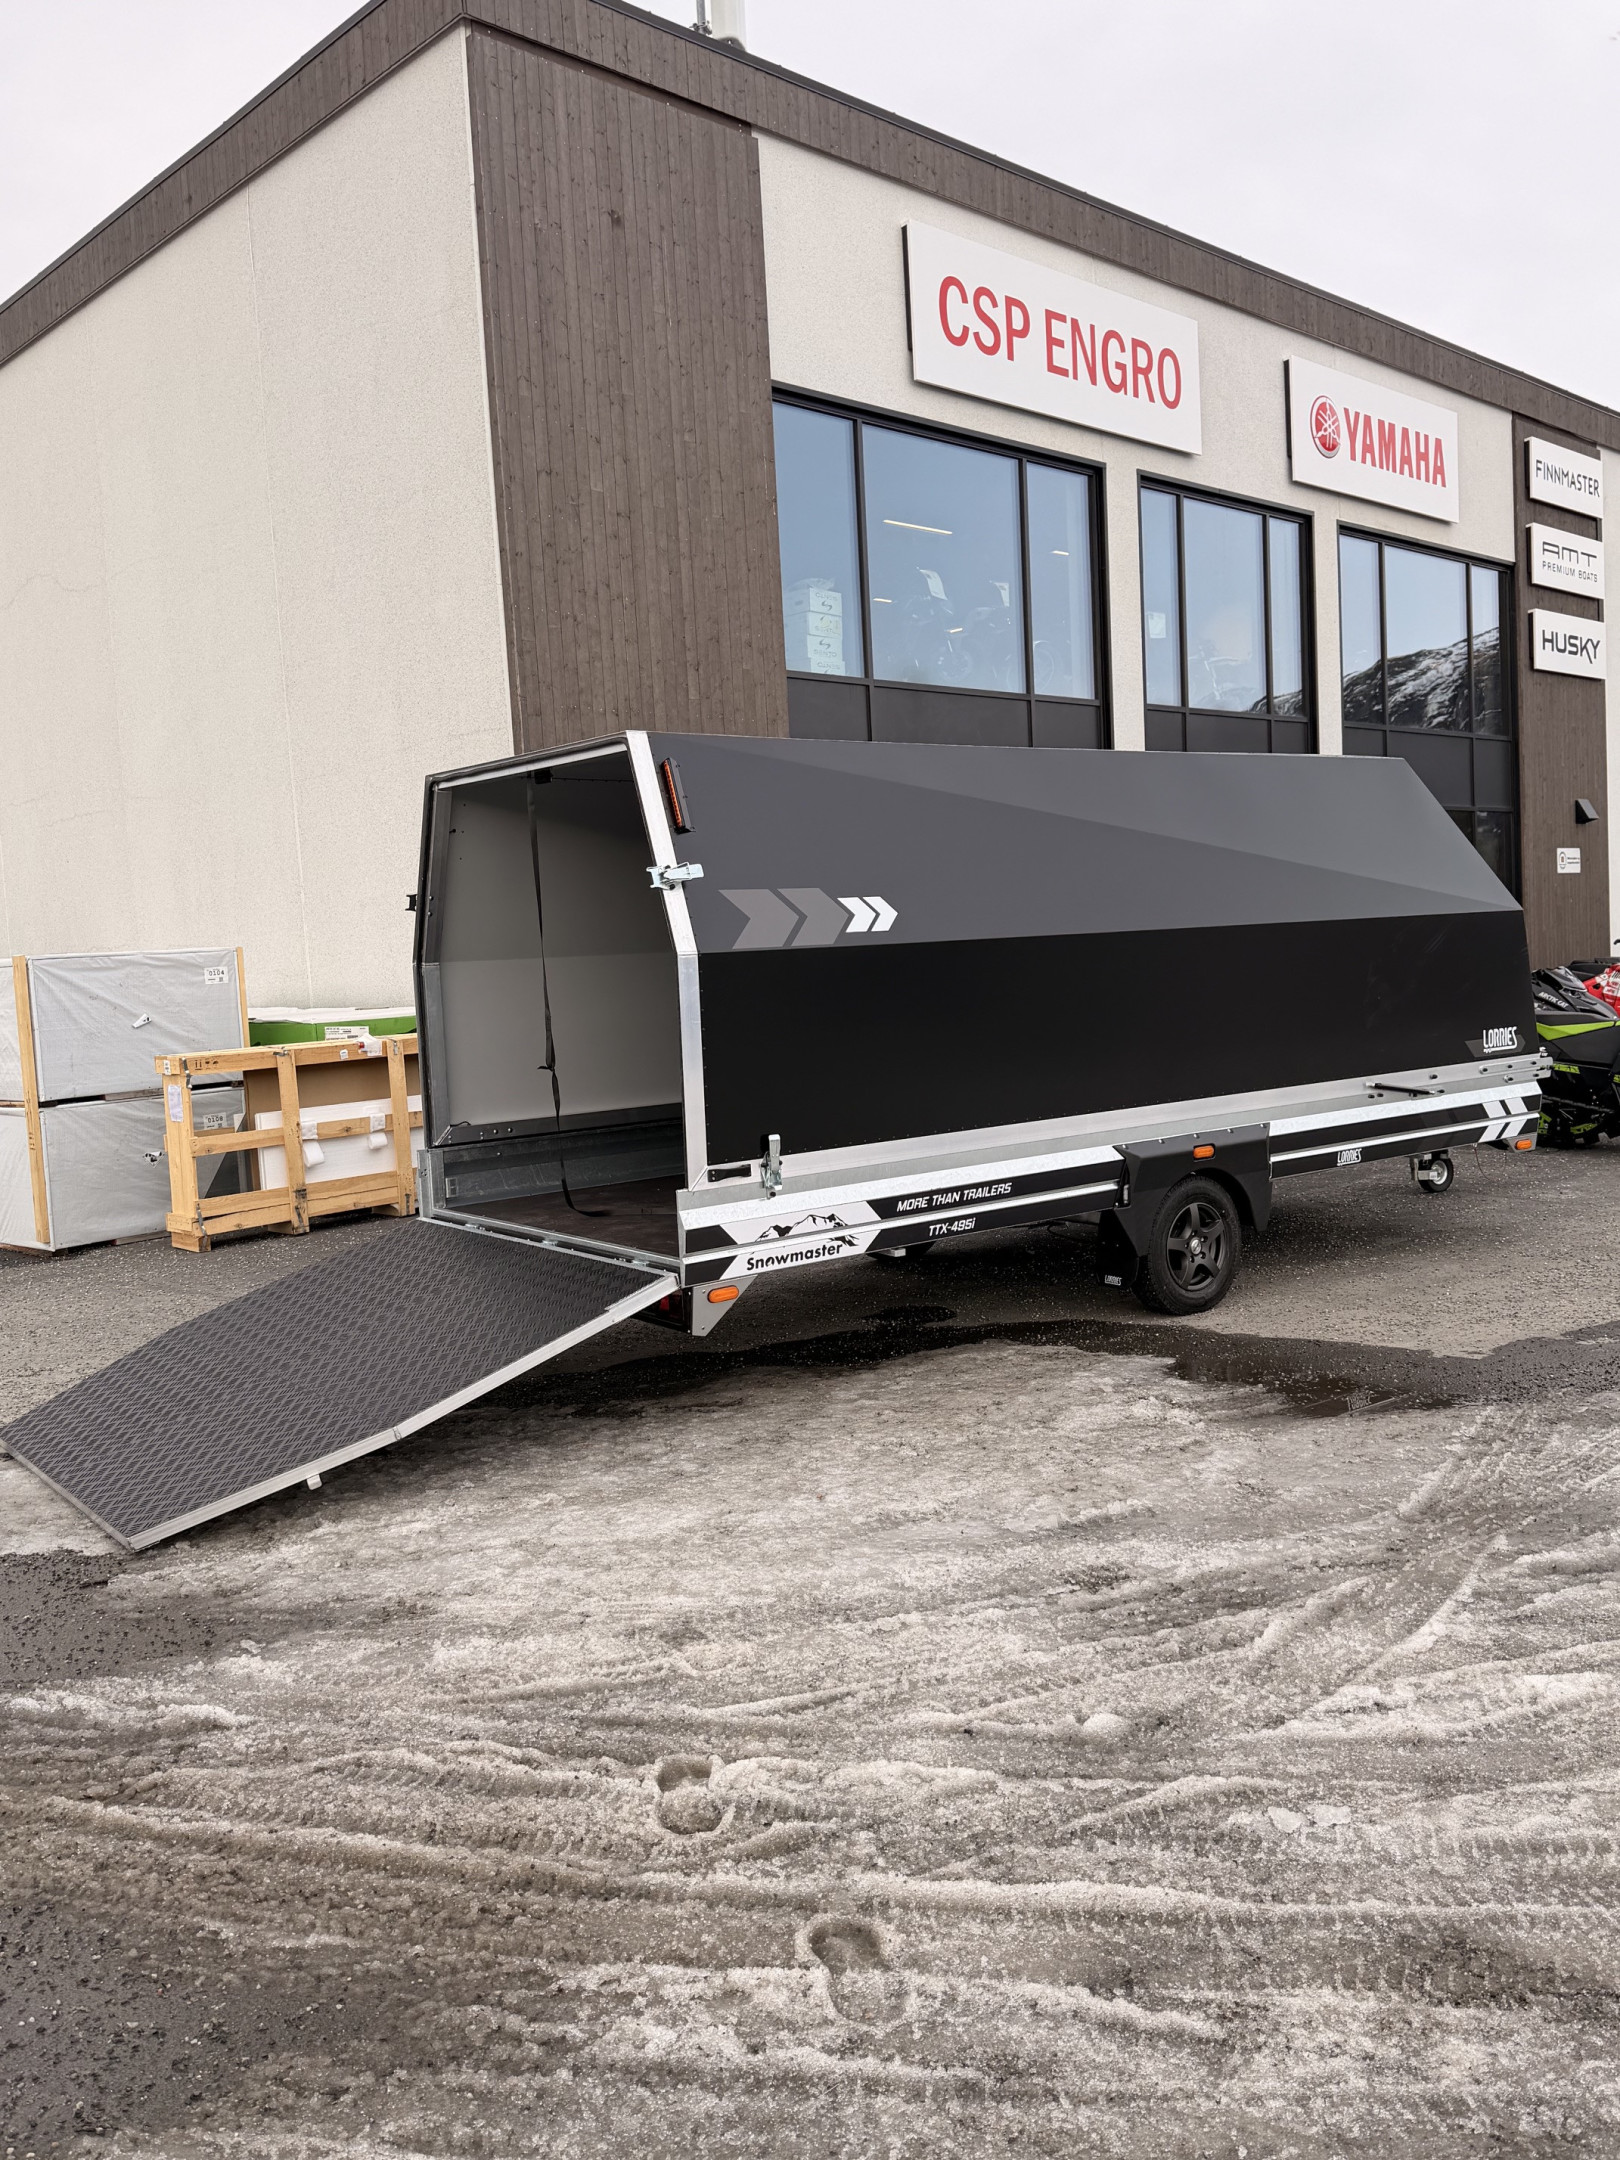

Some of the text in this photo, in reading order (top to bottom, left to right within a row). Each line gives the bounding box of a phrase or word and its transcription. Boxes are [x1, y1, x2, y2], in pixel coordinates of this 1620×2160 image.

[938, 275, 1182, 410] CSP ENGRO
[1344, 407, 1447, 488] YAMAHA
[1535, 460, 1600, 497] FINNMASTER
[1542, 541, 1597, 567] AMT
[1542, 560, 1598, 583] PREMIUM BOATS
[1542, 629, 1601, 664] HUSKY
[1538, 991, 1569, 1010] ARCTIC CAT
[1483, 1026, 1517, 1052] LORRIES
[896, 1183, 1012, 1212] MORE THAN TRAILERS
[928, 1218, 976, 1237] TTX-495i
[746, 1242, 844, 1271] Snowmaster
